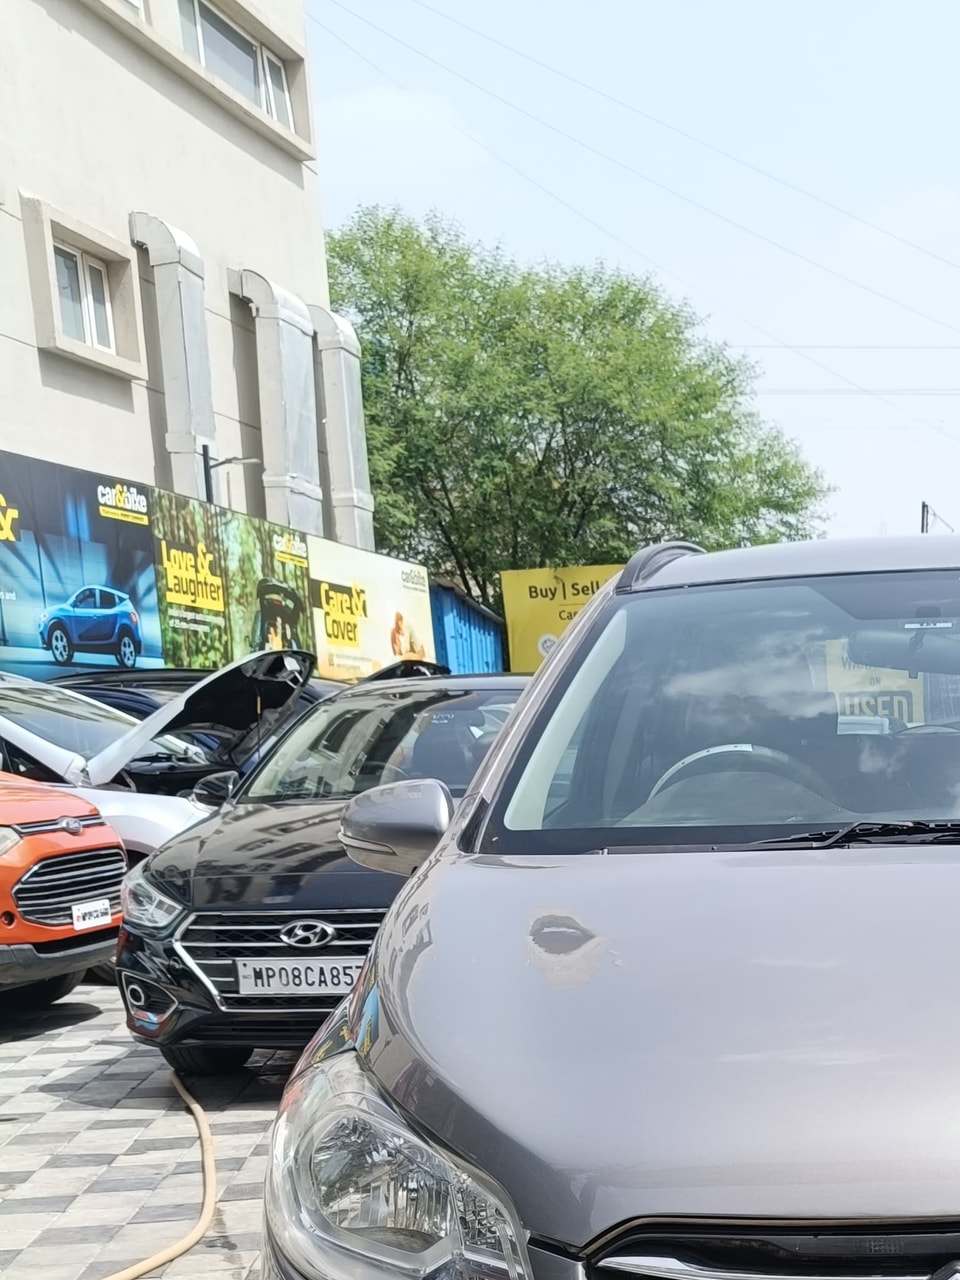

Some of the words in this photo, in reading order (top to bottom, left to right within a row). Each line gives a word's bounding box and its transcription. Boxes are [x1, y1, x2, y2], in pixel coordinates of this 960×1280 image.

[97, 484, 147, 513] car&bike
[161, 540, 195, 571] Love
[197, 542, 214, 577] &
[167, 571, 221, 603] Laughter
[321, 583, 351, 614] Care
[528, 585, 557, 600] Buy
[571, 581, 600, 596] Sell
[325, 611, 357, 642] Cover
